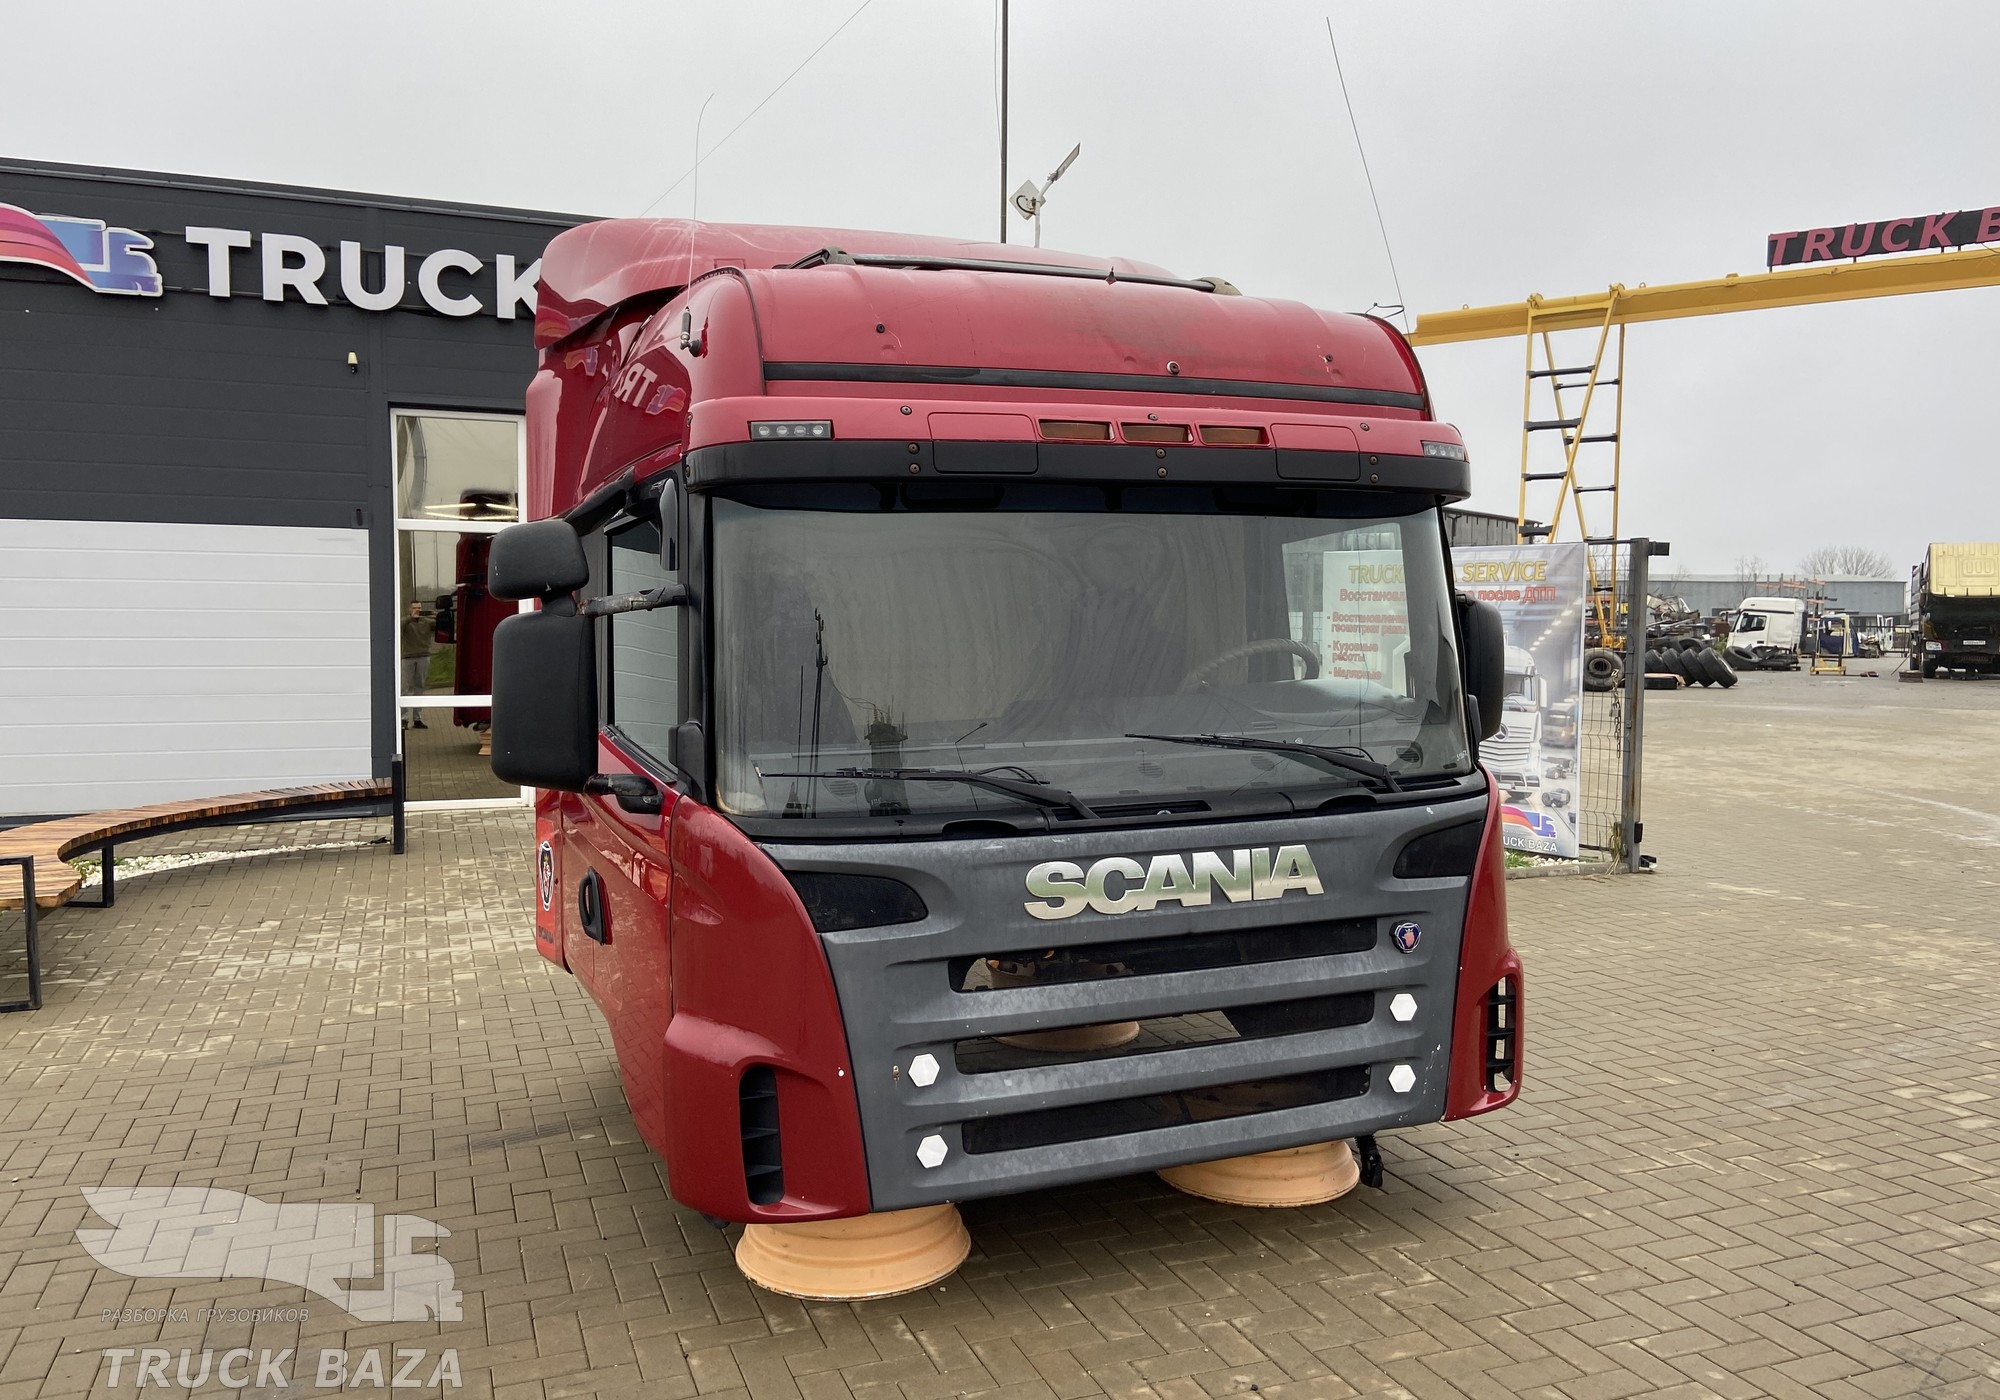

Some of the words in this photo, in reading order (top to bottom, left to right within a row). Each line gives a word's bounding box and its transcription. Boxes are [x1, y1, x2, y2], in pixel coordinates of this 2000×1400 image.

[1769, 211, 1960, 266] TRUCK
[185, 225, 542, 319] TRUCK
[1348, 564, 1405, 584] TRUCK
[1462, 561, 1548, 582] SERVICE
[1478, 590, 1521, 601] после
[1523, 586, 1556, 604] ДТП
[1503, 836, 1525, 848] UCK
[1528, 840, 1558, 852] BAZA
[1023, 844, 1324, 920] SCANIA
